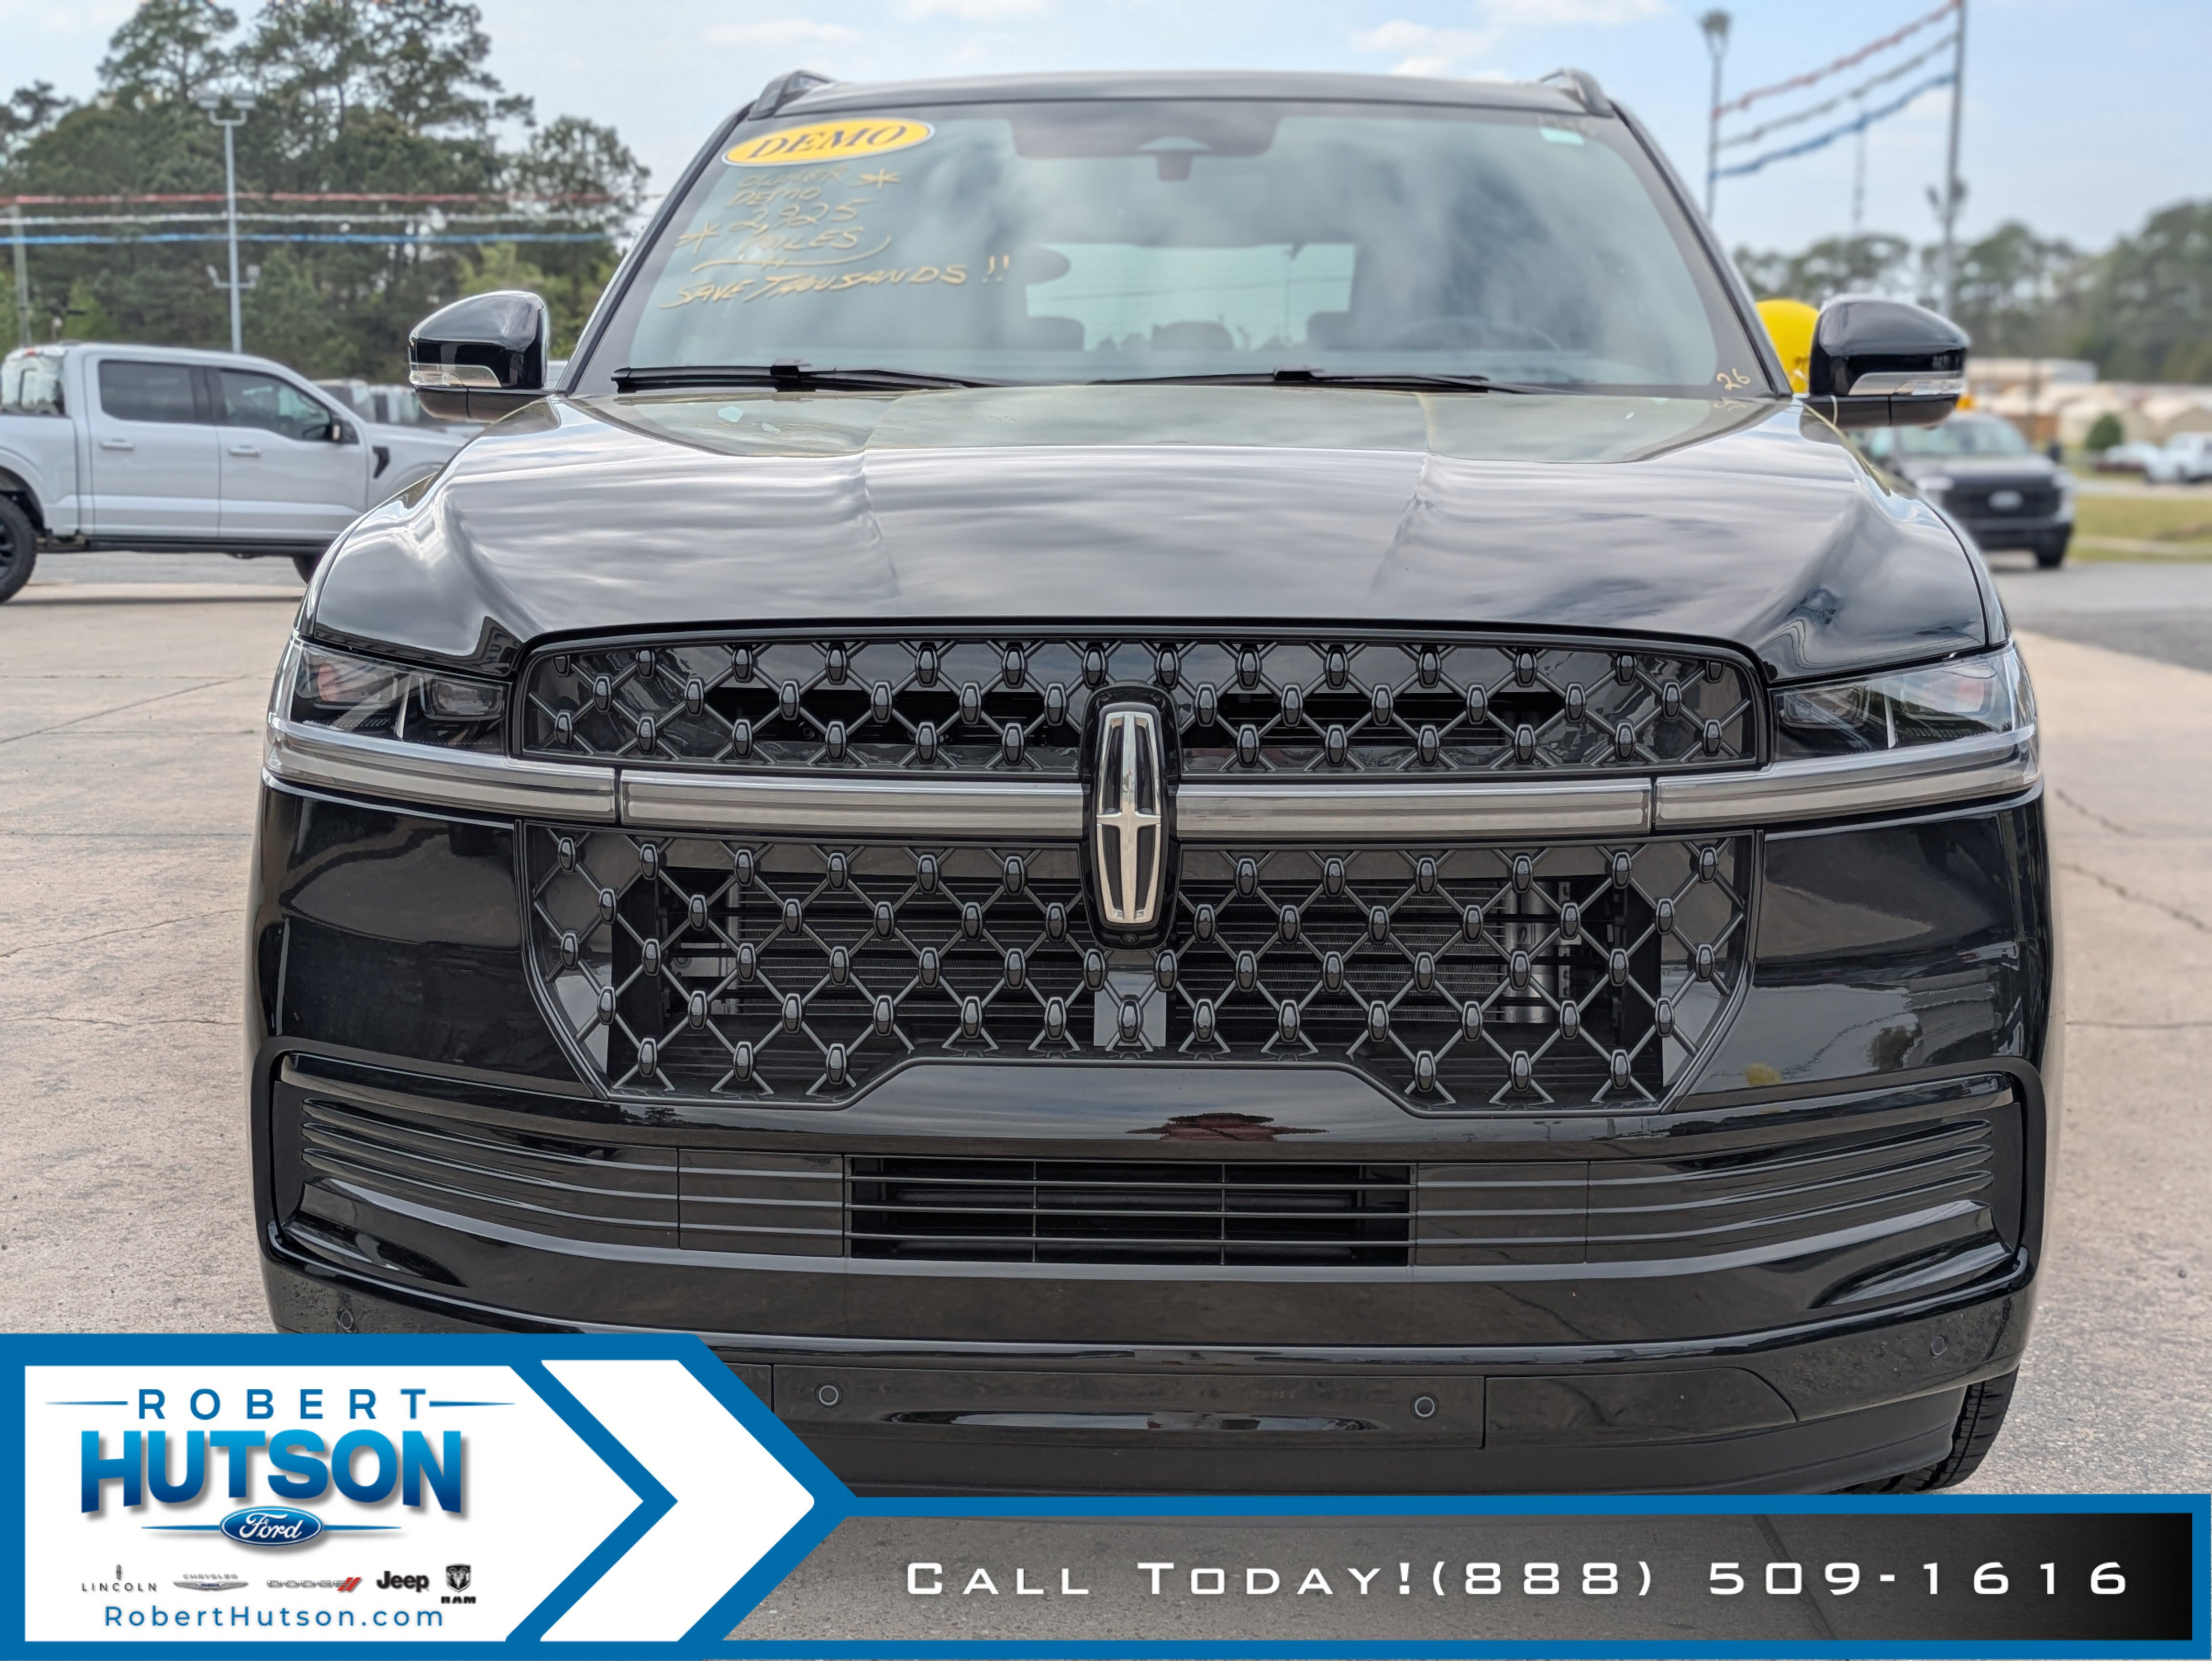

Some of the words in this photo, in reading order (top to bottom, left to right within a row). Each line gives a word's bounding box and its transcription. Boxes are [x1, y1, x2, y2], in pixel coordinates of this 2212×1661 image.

[747, 125, 907, 159] DEMO
[725, 187, 822, 208] DEMO
[738, 226, 865, 254] MILES
[660, 279, 756, 309] SAVE
[743, 264, 968, 302] THOUSANDS
[1716, 367, 1750, 391] 26
